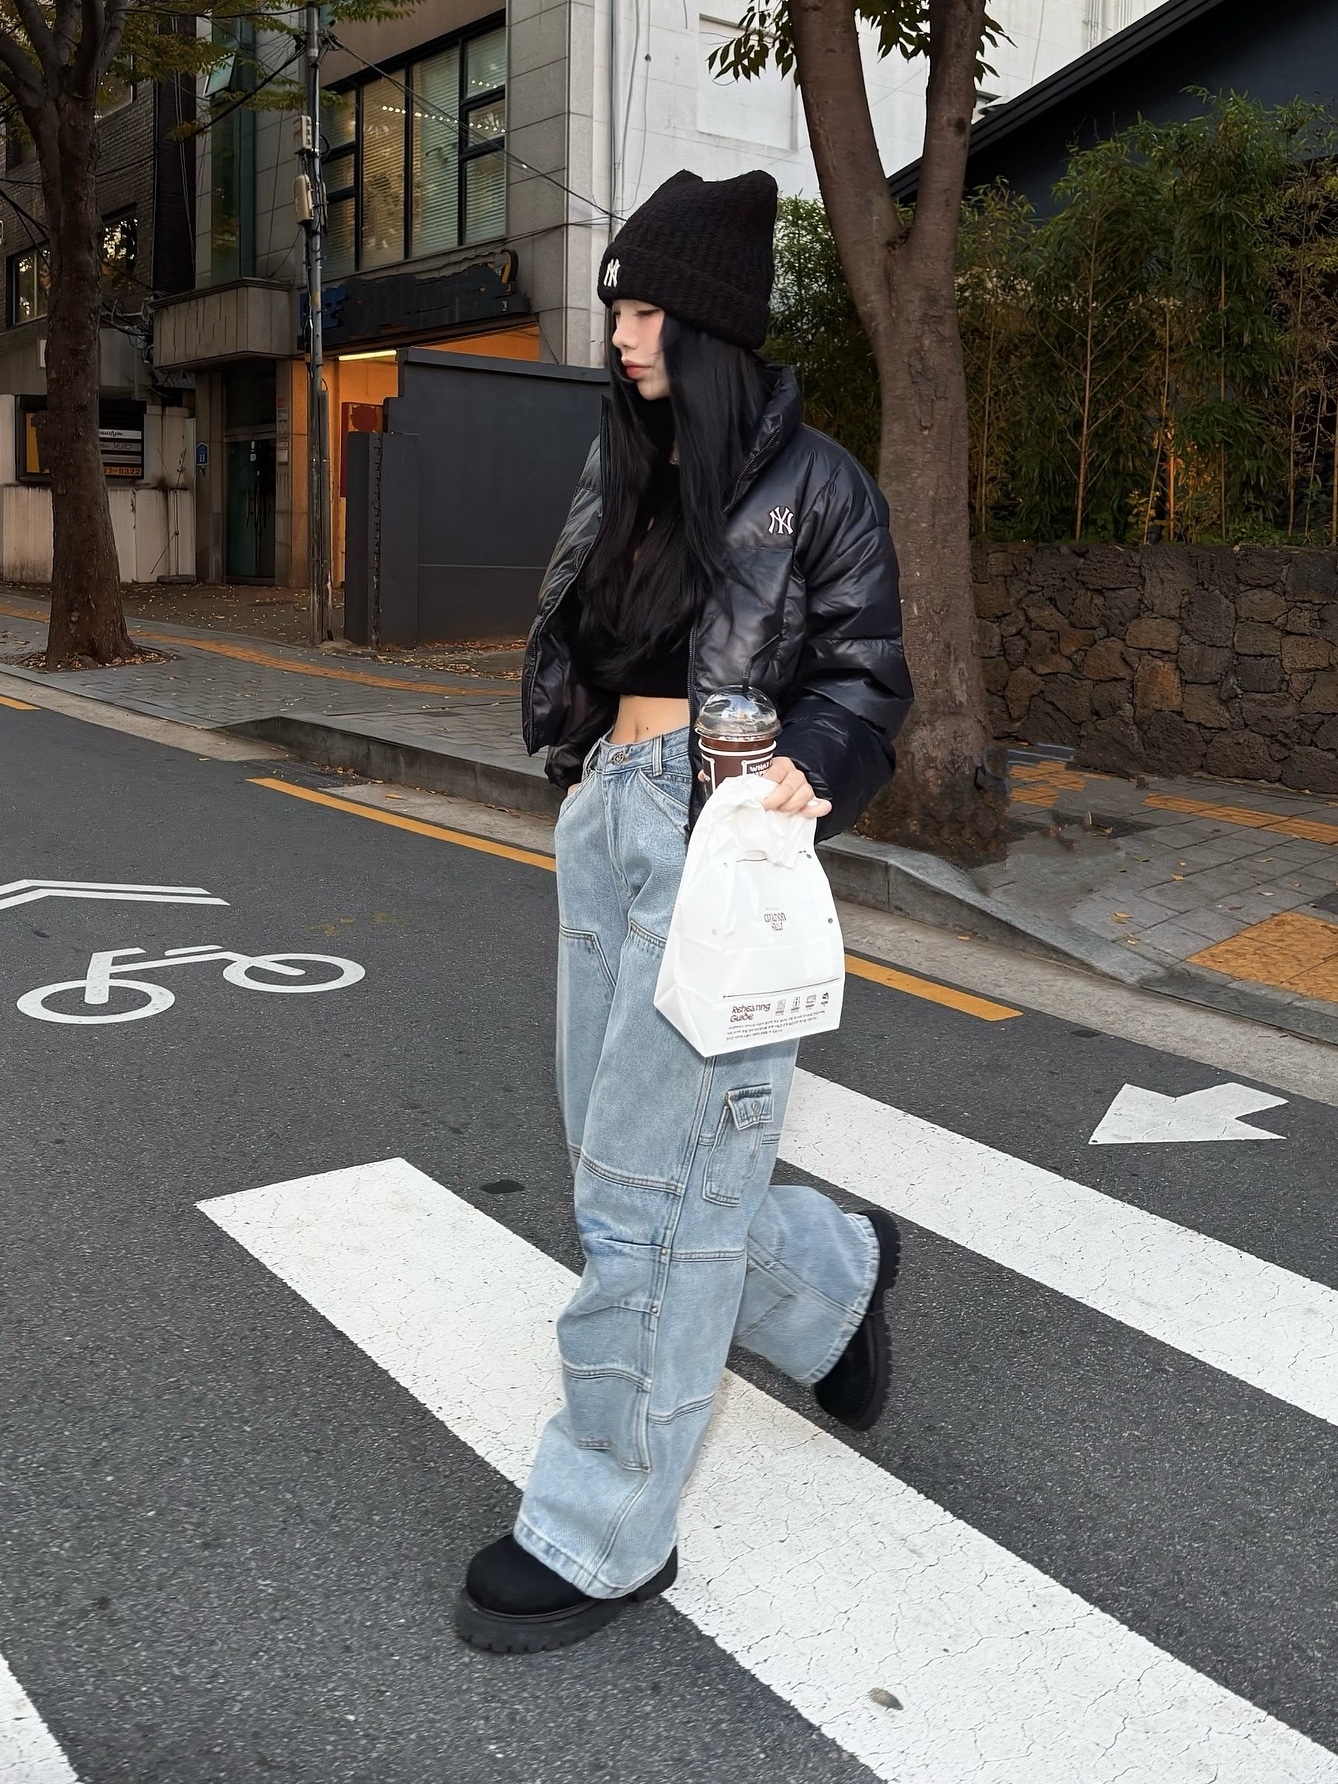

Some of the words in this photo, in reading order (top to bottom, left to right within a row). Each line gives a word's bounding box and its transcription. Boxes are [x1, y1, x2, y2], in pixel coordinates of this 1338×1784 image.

[603, 258, 621, 288] NY
[768, 506, 794, 535] NY
[749, 761, 770, 772] WHAT
[729, 1012, 754, 1023] Guide
